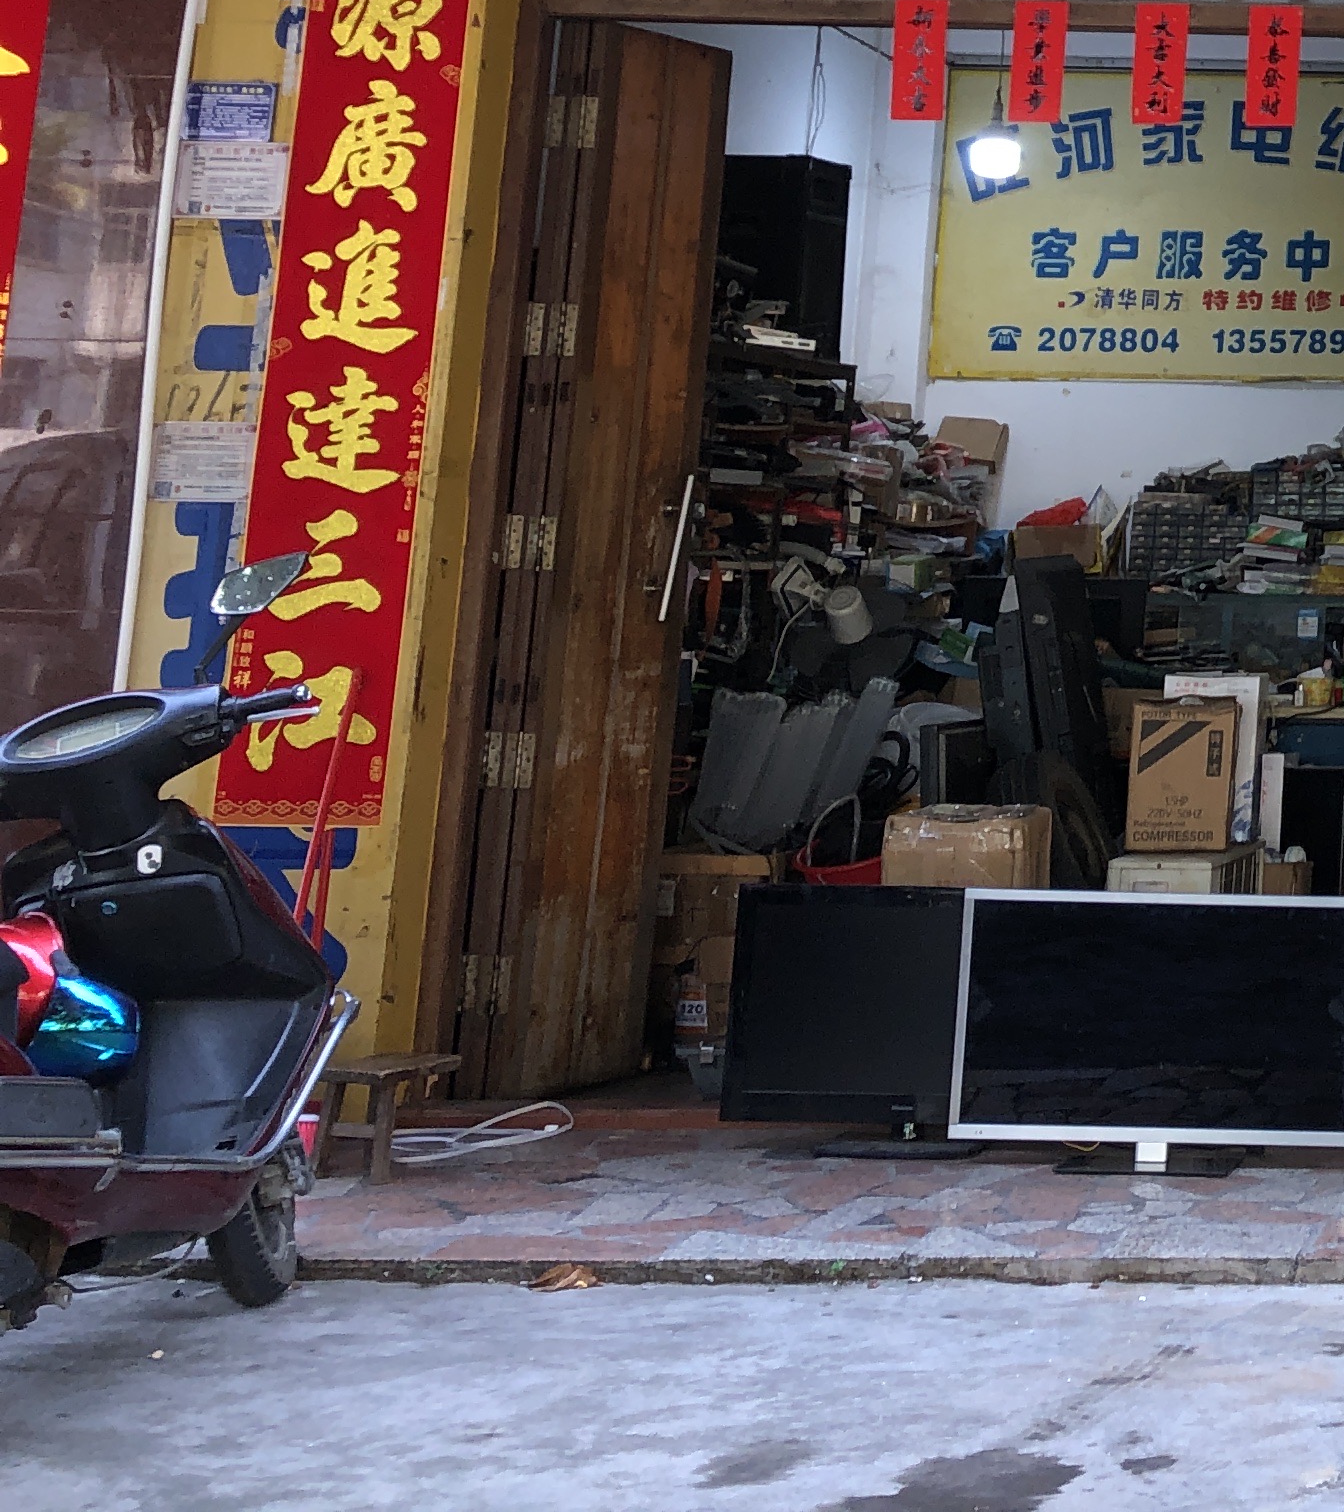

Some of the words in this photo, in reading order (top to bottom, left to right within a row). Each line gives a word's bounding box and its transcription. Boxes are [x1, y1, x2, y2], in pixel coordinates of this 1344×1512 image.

[1145, 11, 1176, 115] 大吉大利
[1093, 287, 1184, 313] 清华同方
[1037, 326, 1181, 355] 2078804
[1132, 830, 1214, 843] COMPRESSOR
[680, 1003, 704, 1015] 120
